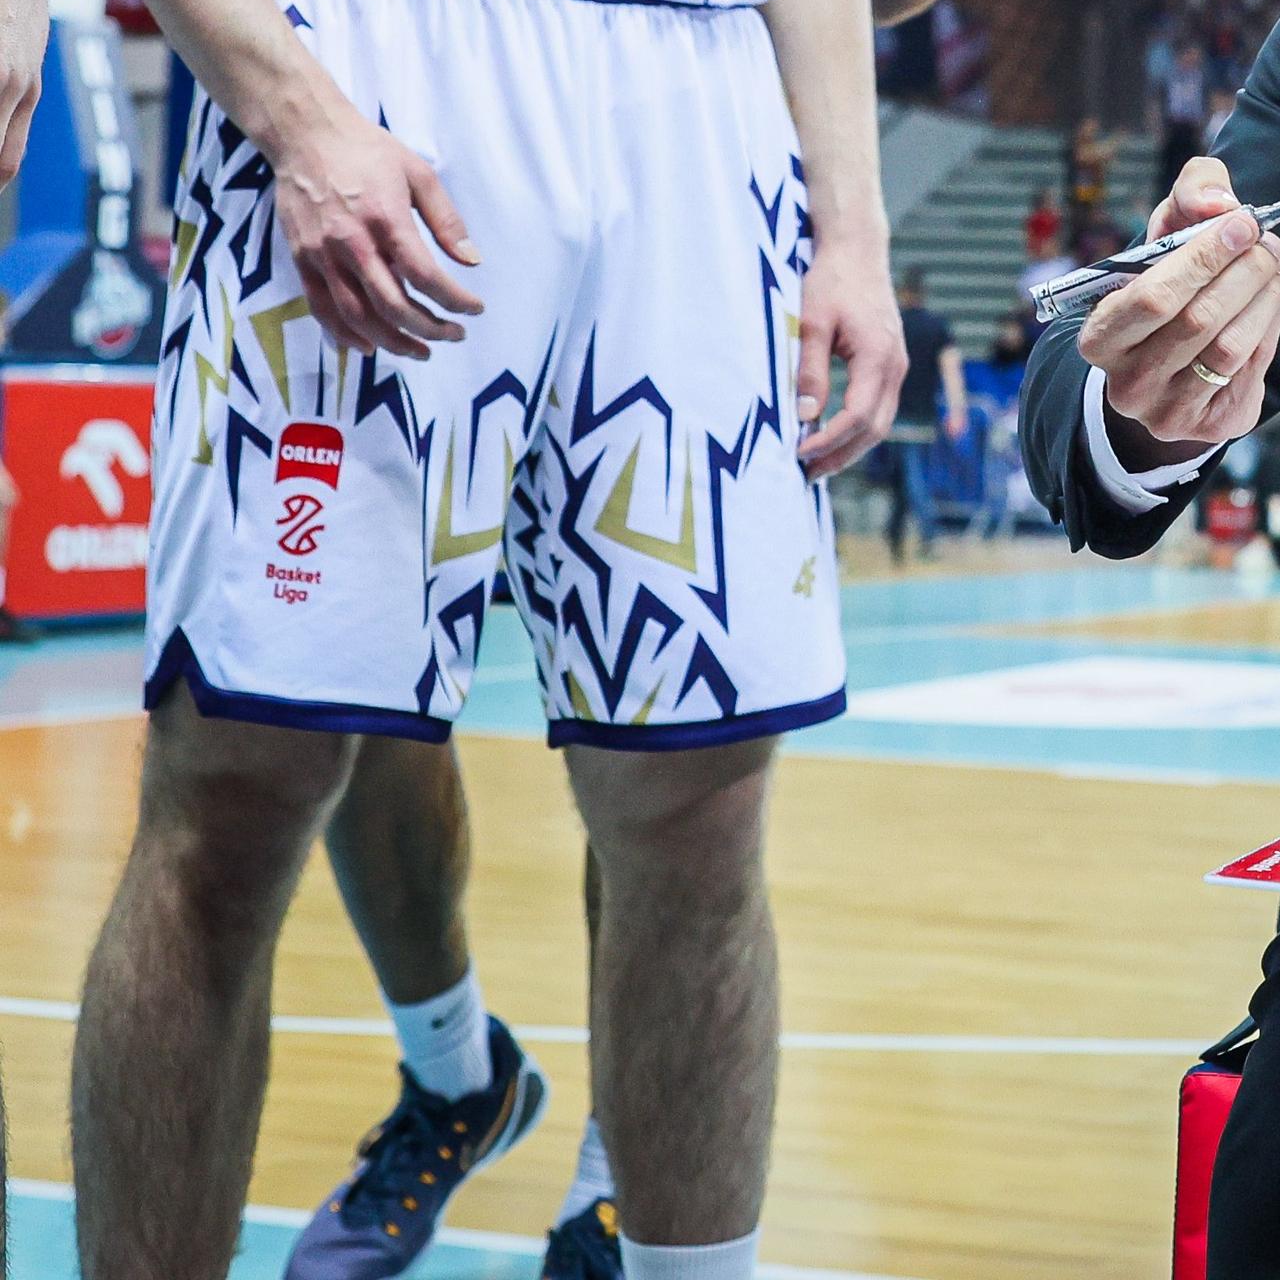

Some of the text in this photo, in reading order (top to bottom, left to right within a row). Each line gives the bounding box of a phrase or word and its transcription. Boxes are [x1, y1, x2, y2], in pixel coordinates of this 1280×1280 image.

[281, 444, 341, 467] ORLEN
[266, 563, 321, 585] Basket
[273, 583, 308, 605] Liga
